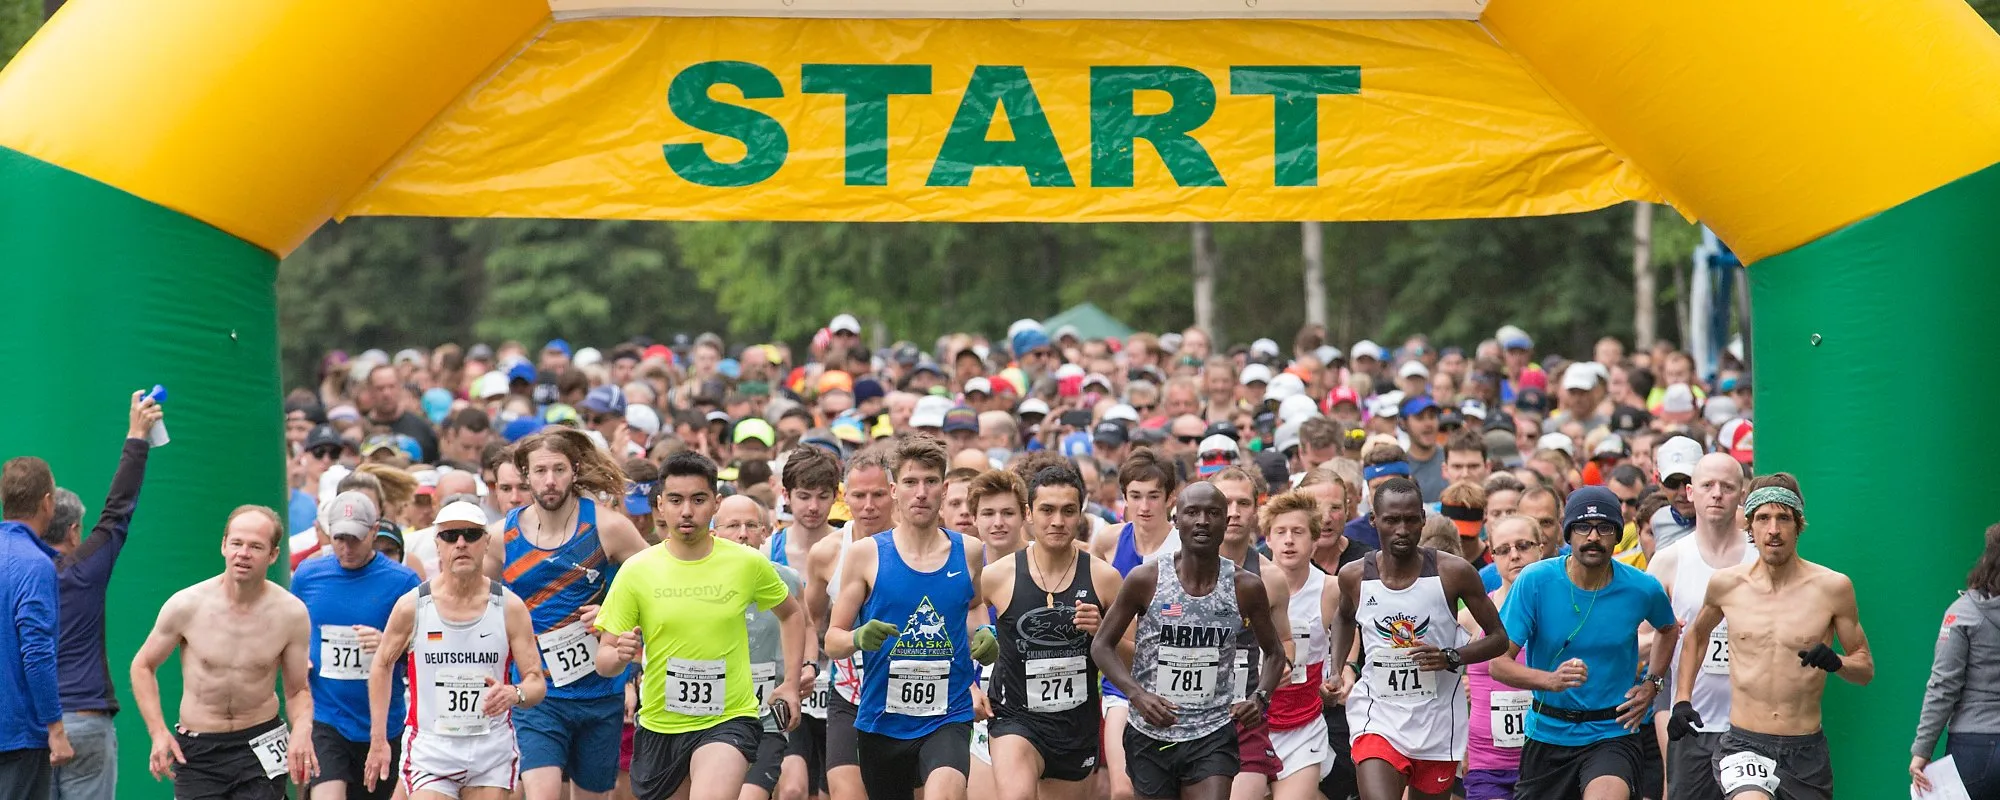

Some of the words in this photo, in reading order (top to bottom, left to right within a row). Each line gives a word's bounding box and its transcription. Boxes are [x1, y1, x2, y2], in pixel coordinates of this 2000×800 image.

[660, 59, 1362, 188] START
[653, 584, 723, 599] saucony
[896, 640, 951, 648] ALASKA
[1159, 624, 1232, 648] ARMY
[333, 647, 362, 668] 371
[424, 652, 499, 664] DEUTSCHLAND
[556, 643, 590, 672] 523
[1041, 678, 1073, 701] 274
[1171, 669, 1203, 691] 781
[1388, 668, 1422, 691] 471
[448, 690, 480, 712] 367
[678, 681, 712, 704] 333
[801, 690, 828, 709] 80
[901, 682, 936, 704] 669
[266, 737, 288, 763] 59
[1734, 763, 1768, 778] 309
